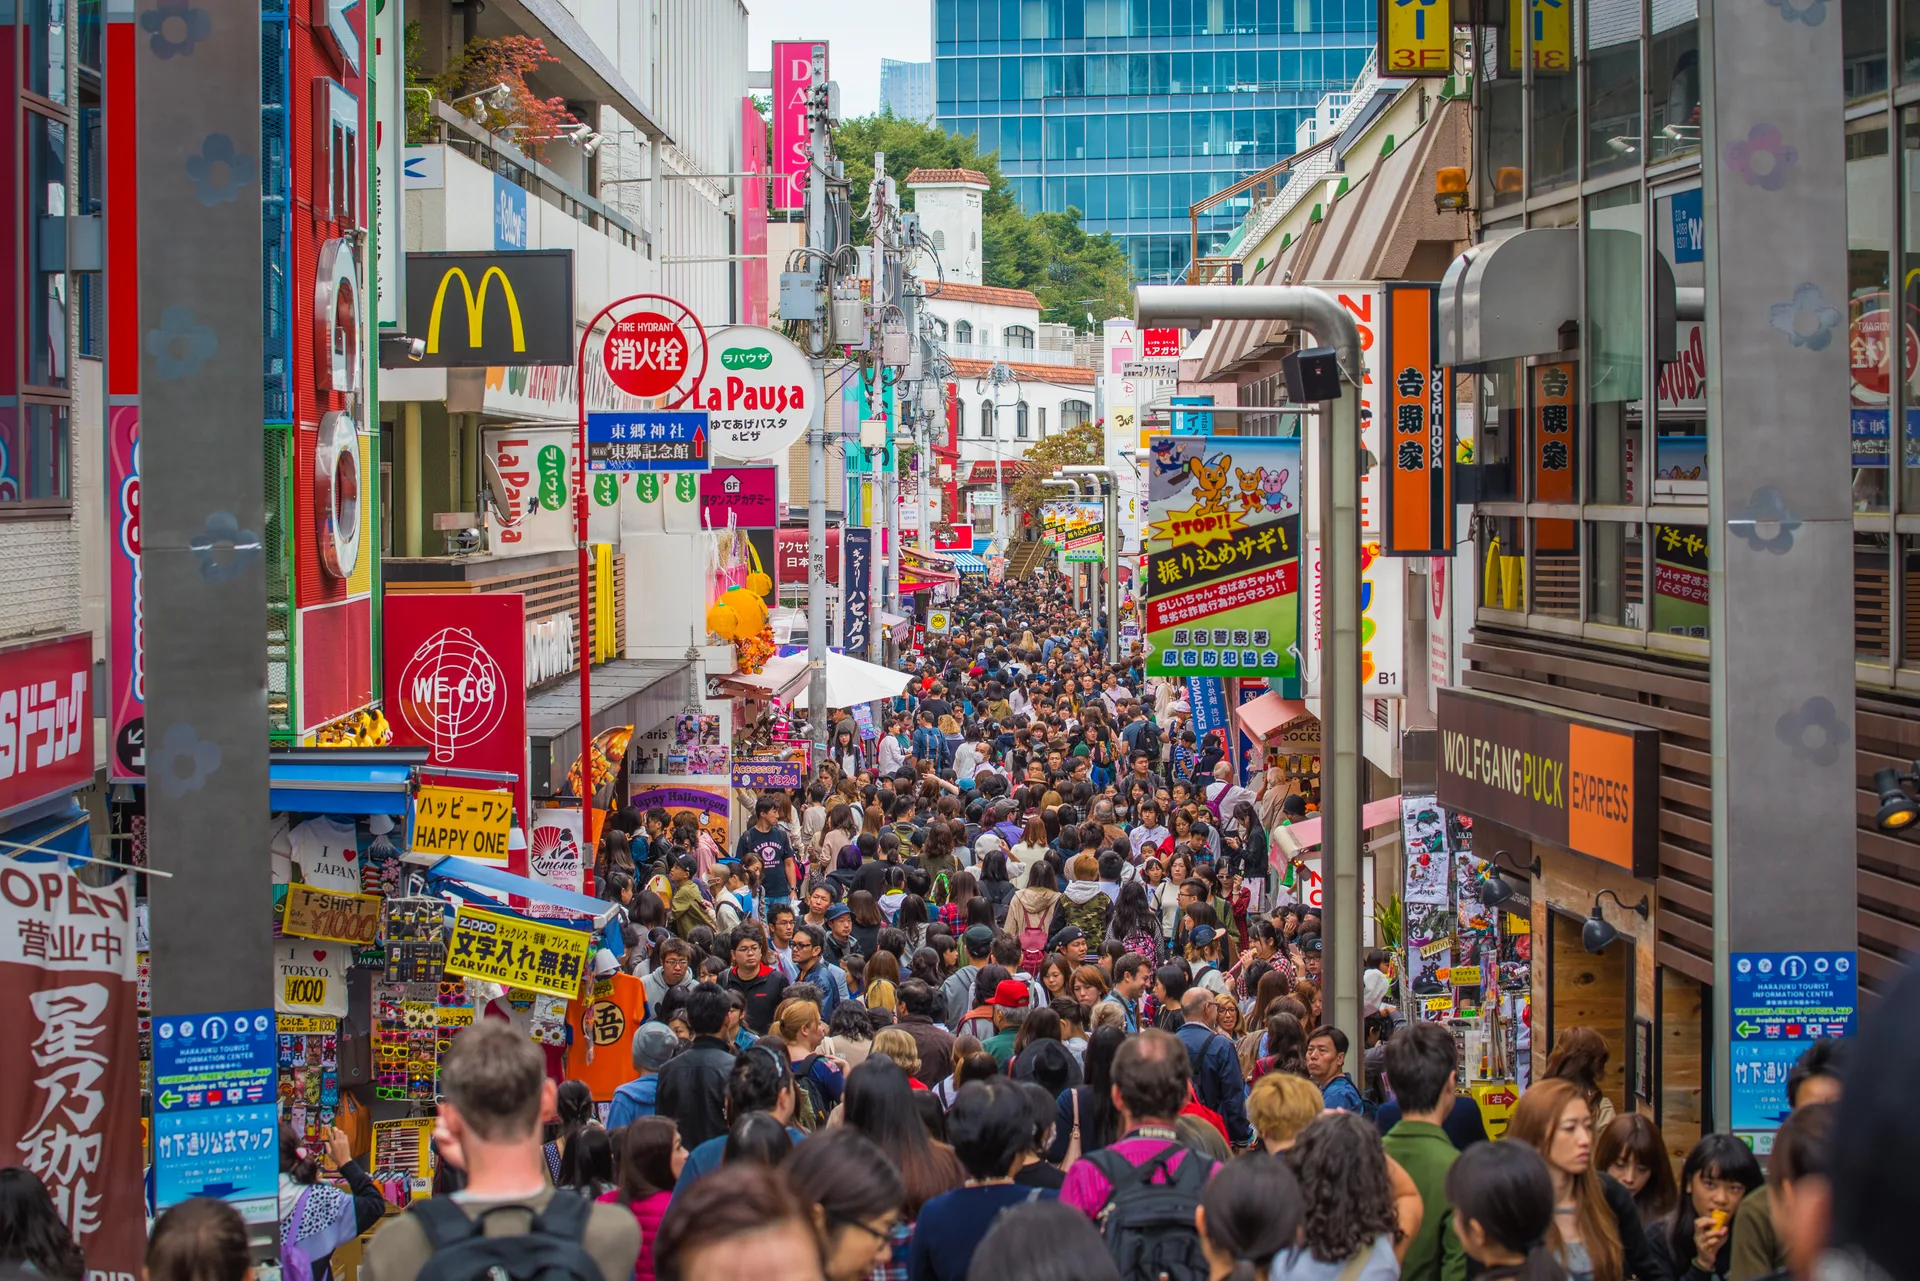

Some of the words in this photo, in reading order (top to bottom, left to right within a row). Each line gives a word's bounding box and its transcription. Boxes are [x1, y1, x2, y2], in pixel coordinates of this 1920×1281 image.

[1393, 49, 1446, 68] 3F
[618, 322, 635, 332] FIRE
[638, 322, 674, 332] HYDRANT
[610, 337, 683, 371] 消火栓
[1143, 365, 1176, 377] クリスティー
[727, 376, 804, 413] Pausa
[611, 423, 685, 439] 東郷神社
[1397, 366, 1425, 472] 吉野家
[611, 443, 689, 460] 東郷記念館
[726, 482, 738, 490] 6F
[1172, 513, 1232, 537] STOP!!
[1158, 526, 1290, 585] 振り込めサギ!
[847, 591, 868, 650] ハセガワ
[1174, 628, 1272, 646] 原宿警察署
[1162, 649, 1279, 668] 原宿防犯協会
[413, 677, 449, 703] WE
[1379, 672, 1396, 684] B1
[733, 764, 782, 774] Accessory
[768, 775, 797, 785] ¥324
[1443, 729, 1521, 795] WOLFGANG
[1523, 752, 1563, 809] PUCK
[1572, 771, 1629, 824] EXPRESS
[419, 796, 509, 823] ハッピーワン
[321, 845, 329, 857] I
[416, 826, 469, 851] HAPPY
[473, 831, 506, 854] ONE
[314, 862, 356, 880] JAPAN
[2, 867, 128, 922] OPEN
[302, 890, 365, 914] T-SHIRT
[311, 910, 377, 942] ¥1000
[454, 931, 582, 981] 文字入れ無料
[450, 957, 507, 977] CARVING
[514, 970, 528, 981] IS
[286, 978, 323, 1002] ¥1000
[227, 1052, 254, 1060] CENTER
[159, 1127, 273, 1158] 竹下通り公式マップ
